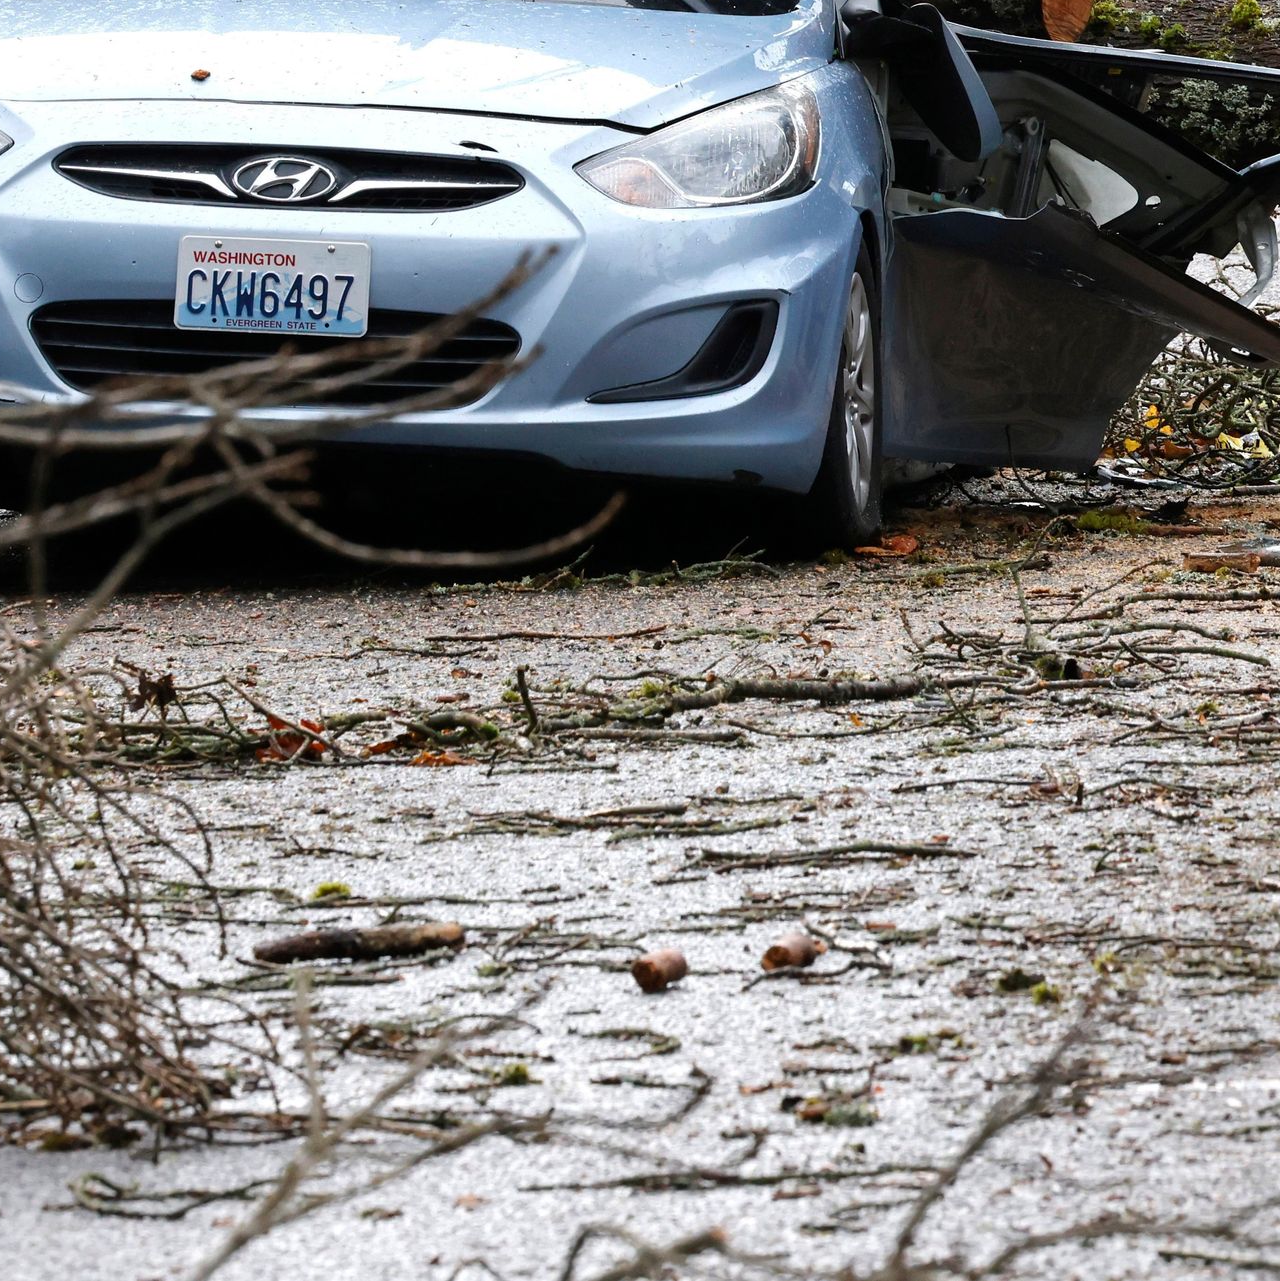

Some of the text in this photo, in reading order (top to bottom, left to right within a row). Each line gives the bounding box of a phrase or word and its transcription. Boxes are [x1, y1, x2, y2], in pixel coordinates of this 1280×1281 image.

[194, 251, 296, 266] WASHINGTON
[187, 269, 354, 321] CKW6497
[226, 319, 317, 330] EVERGREEN STATE
